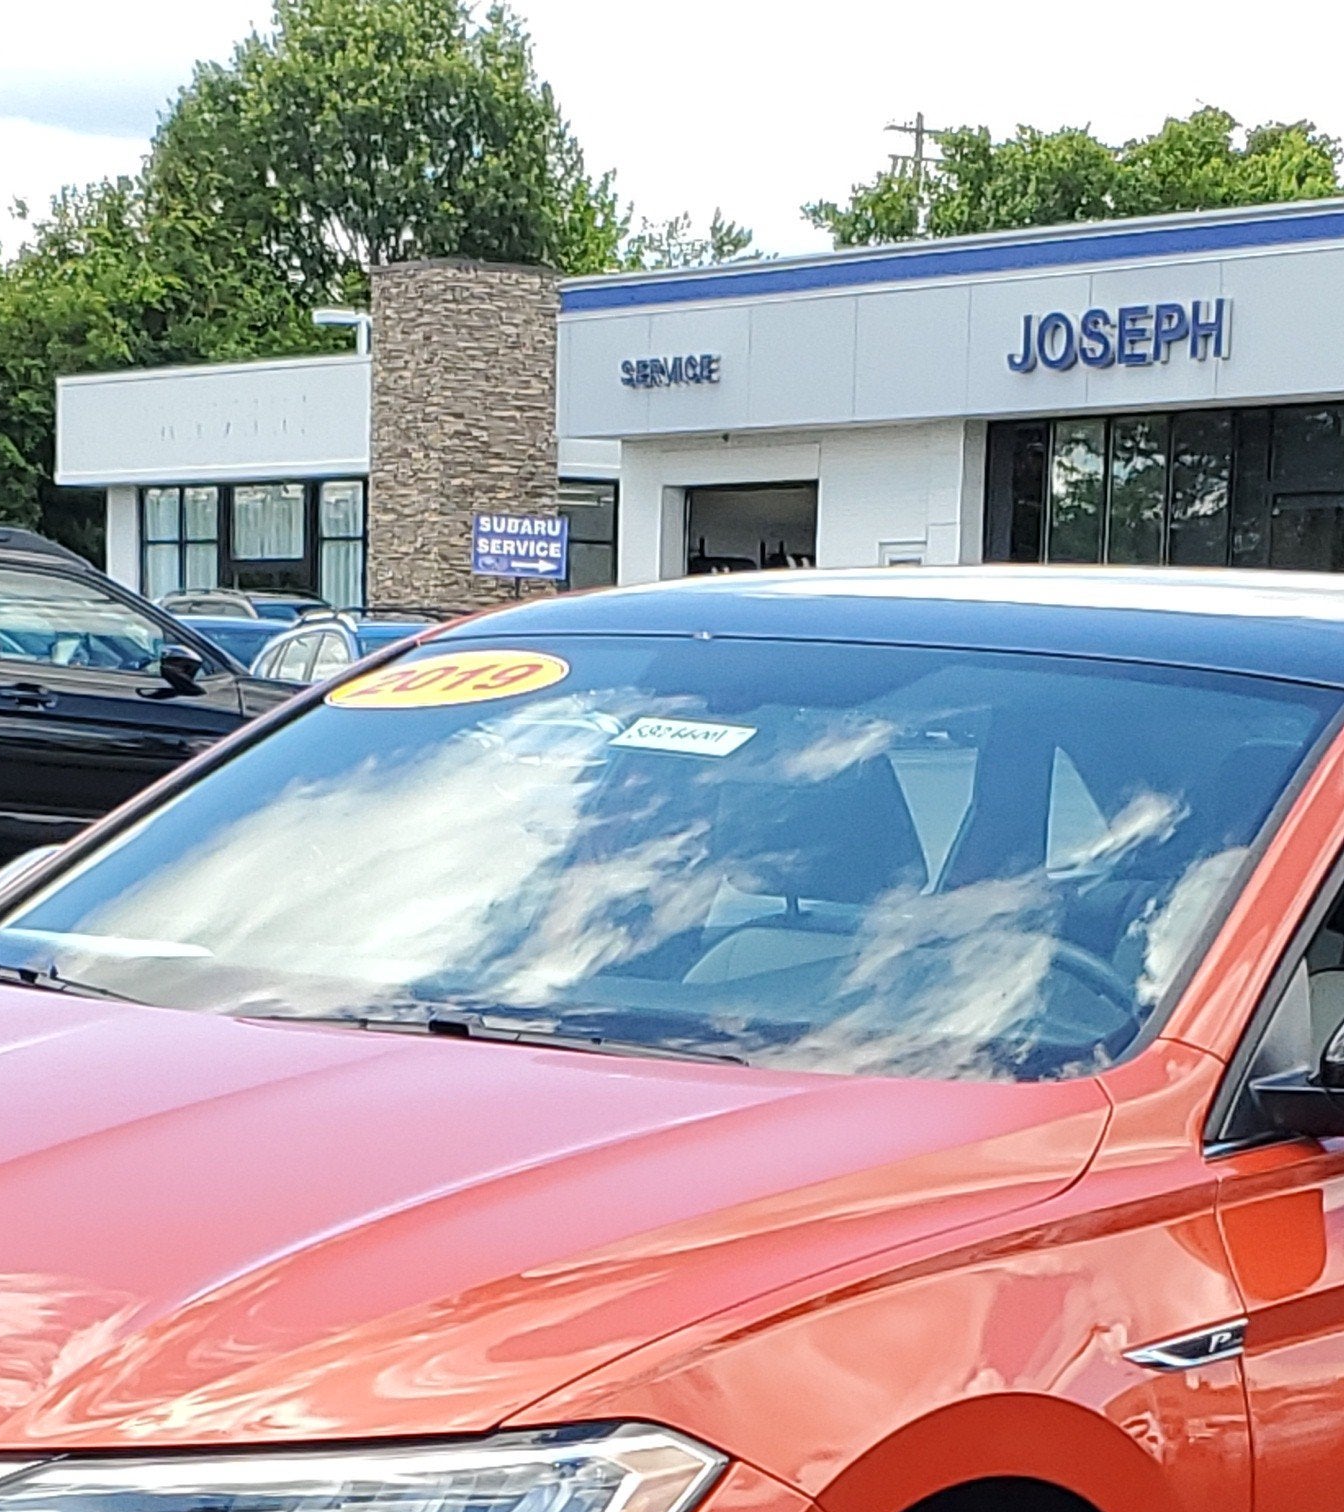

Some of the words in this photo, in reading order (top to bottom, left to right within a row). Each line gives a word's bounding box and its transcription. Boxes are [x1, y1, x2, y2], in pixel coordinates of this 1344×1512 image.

[1007, 298, 1233, 373] JOSEPH
[620, 354, 721, 389] SERVICE
[478, 516, 562, 537] SUBARU
[476, 538, 562, 558] SERVICE
[343, 663, 544, 698] 2019
